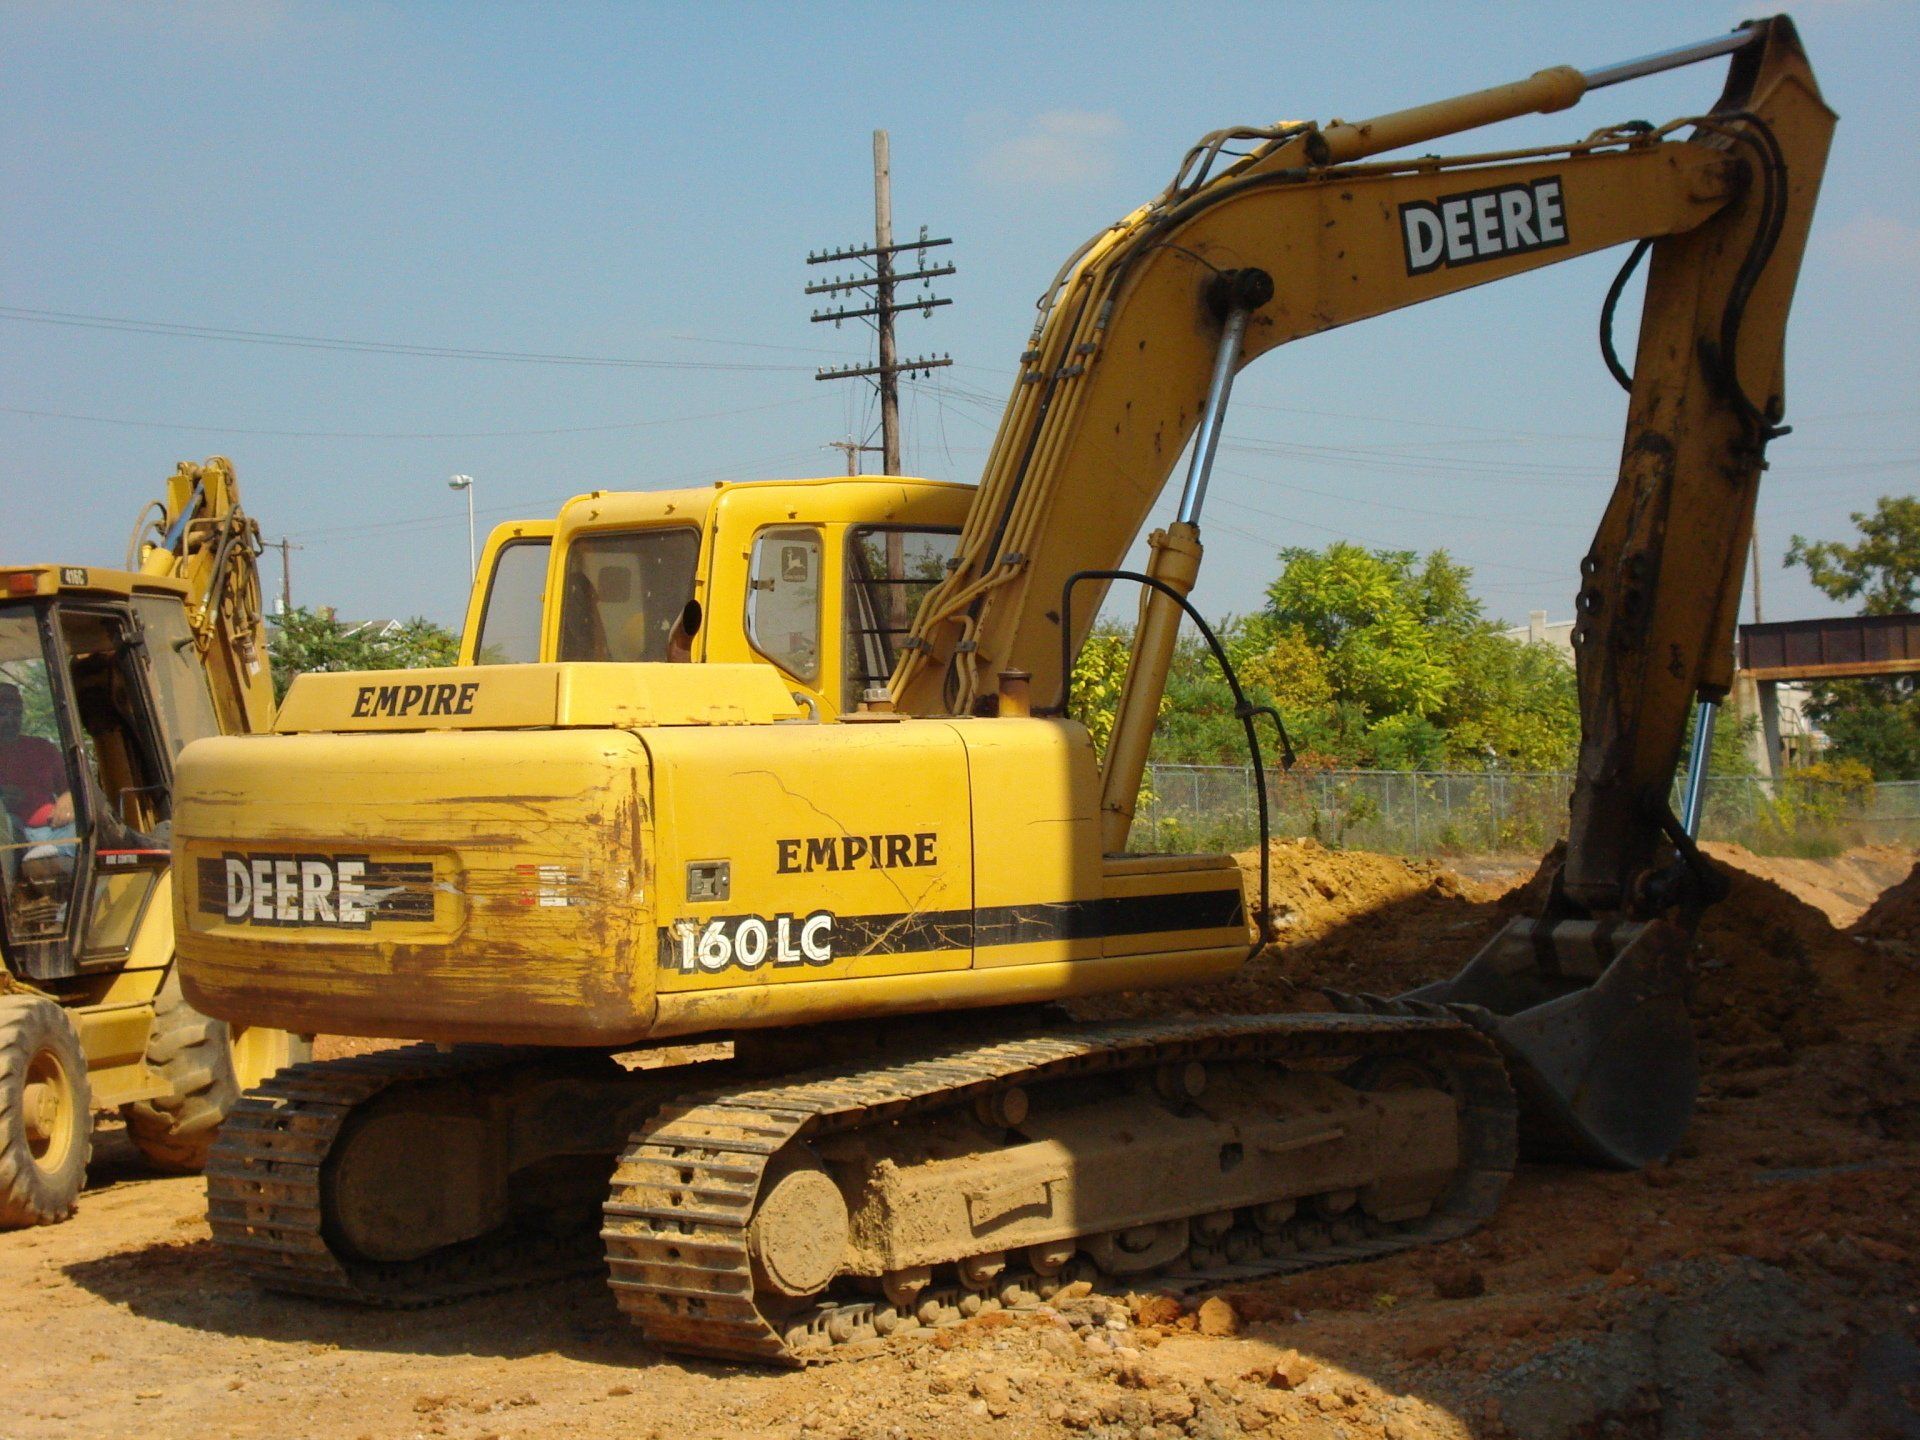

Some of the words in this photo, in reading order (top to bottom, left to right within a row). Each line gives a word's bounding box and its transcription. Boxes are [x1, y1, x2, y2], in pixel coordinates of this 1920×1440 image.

[1405, 182, 1566, 268] DEERE
[351, 683, 480, 717] EMPIRE
[776, 832, 937, 874] EMPIRE
[226, 858, 367, 923] DEERE
